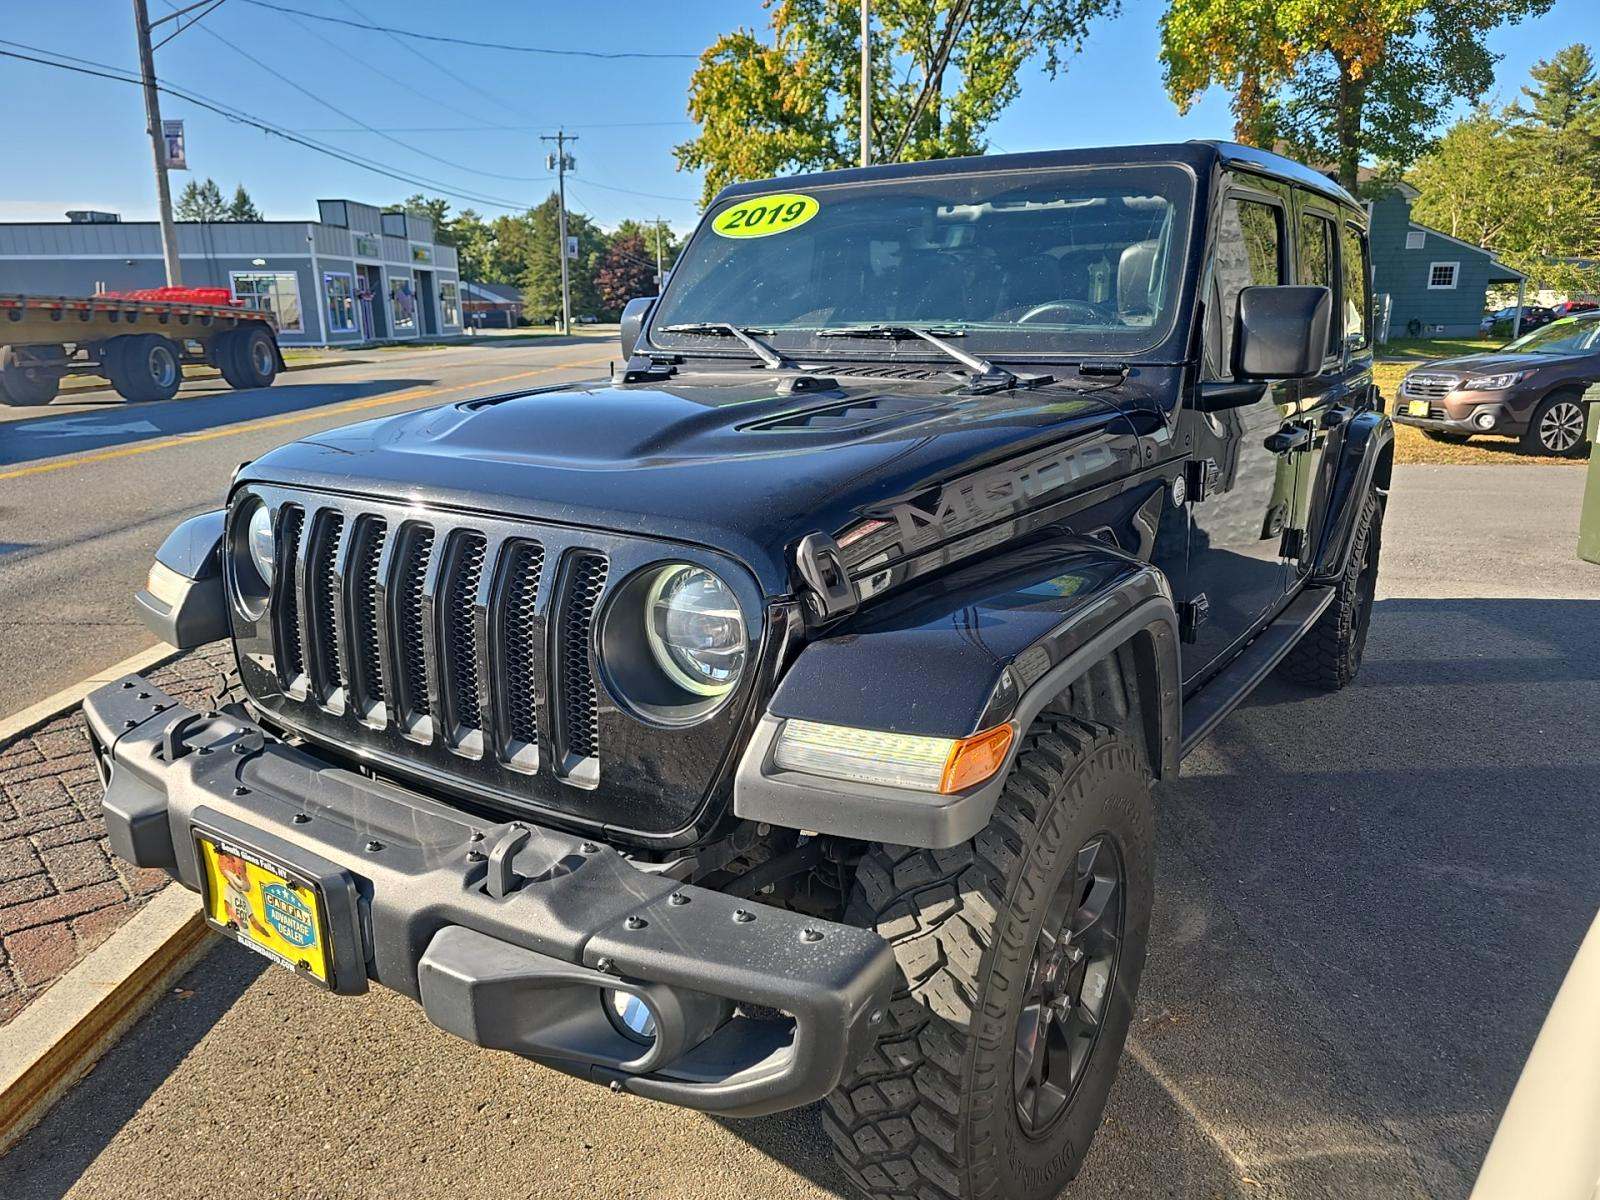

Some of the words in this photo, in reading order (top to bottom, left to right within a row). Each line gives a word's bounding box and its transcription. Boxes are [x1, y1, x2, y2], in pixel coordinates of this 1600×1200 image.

[723, 201, 806, 230] 2019
[234, 897, 247, 910] CAR
[266, 894, 311, 923] CARFAX
[271, 908, 309, 937] ADVANTAGE
[279, 922, 304, 945] DEALER
